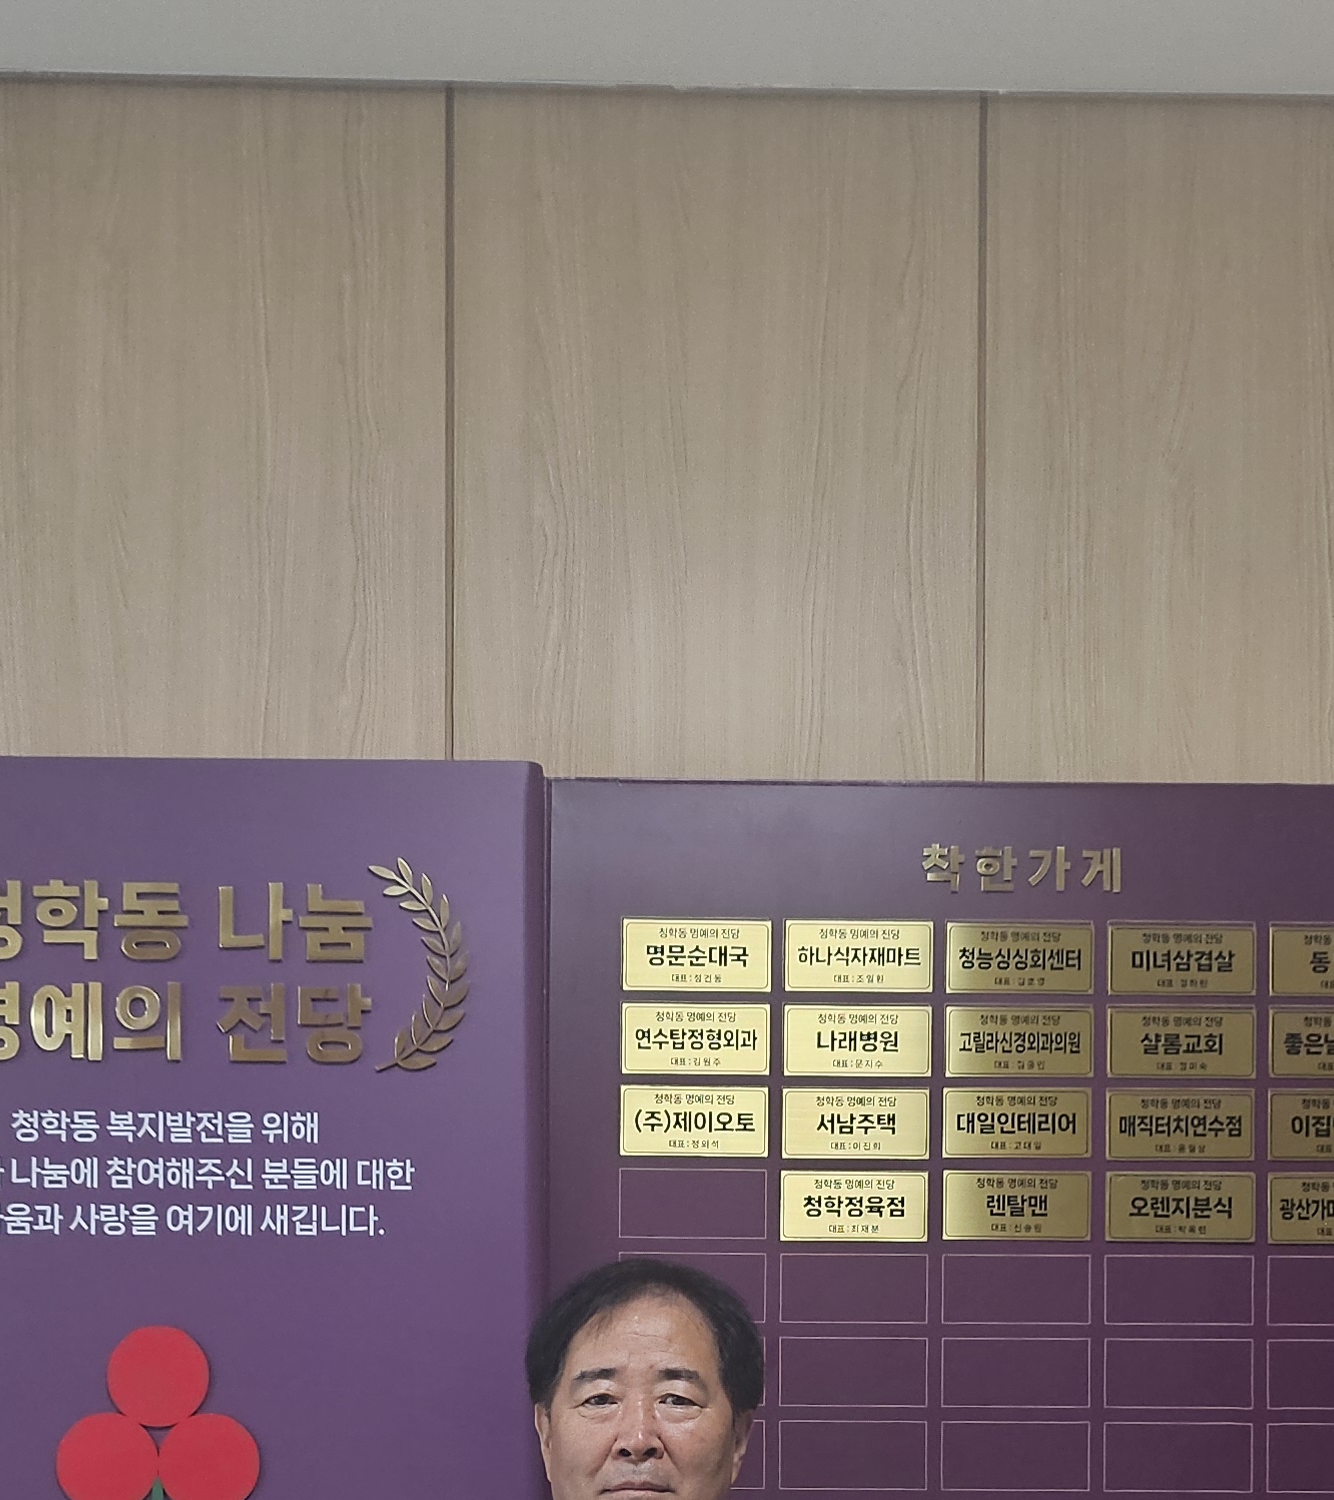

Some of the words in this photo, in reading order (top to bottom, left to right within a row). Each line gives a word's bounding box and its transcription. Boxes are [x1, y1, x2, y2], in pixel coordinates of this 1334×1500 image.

[922, 843, 1123, 893] 착한가게
[217, 881, 373, 962] 나눔
[646, 944, 749, 967] 명문순대국
[797, 946, 921, 967] 하나식자재마트
[1131, 949, 1236, 972] 미녀삼겹살
[216, 982, 373, 1064] 전당
[635, 1028, 758, 1051] 연수탑정형외과
[816, 1030, 899, 1052] 나래병원
[959, 1031, 1081, 1054] 고릴라신경외과의원
[1140, 1033, 1223, 1056] 샬롬교회
[11, 1110, 100, 1144] 청학동
[106, 1110, 254, 1145] 복지발전을
[261, 1111, 320, 1144] 위해
[634, 1109, 755, 1134] (주)제이오토
[816, 1113, 897, 1136] 서남주택
[957, 1112, 1077, 1135] 대일인테리어
[1119, 1114, 1243, 1138] 매직터치연수점
[11, 1156, 100, 1190] 나눔에
[106, 1156, 254, 1190] 참여해주신
[261, 1157, 349, 1190] 분들에
[356, 1157, 415, 1190] 대한
[802, 1195, 906, 1218] 청학정육점
[986, 1194, 1048, 1217] 렌탈맨
[1129, 1195, 1233, 1219] 오렌지분식
[69, 1203, 159, 1237] 사랑을
[165, 1203, 254, 1237] 여기에
[260, 1203, 385, 1237] 새깁니다.
